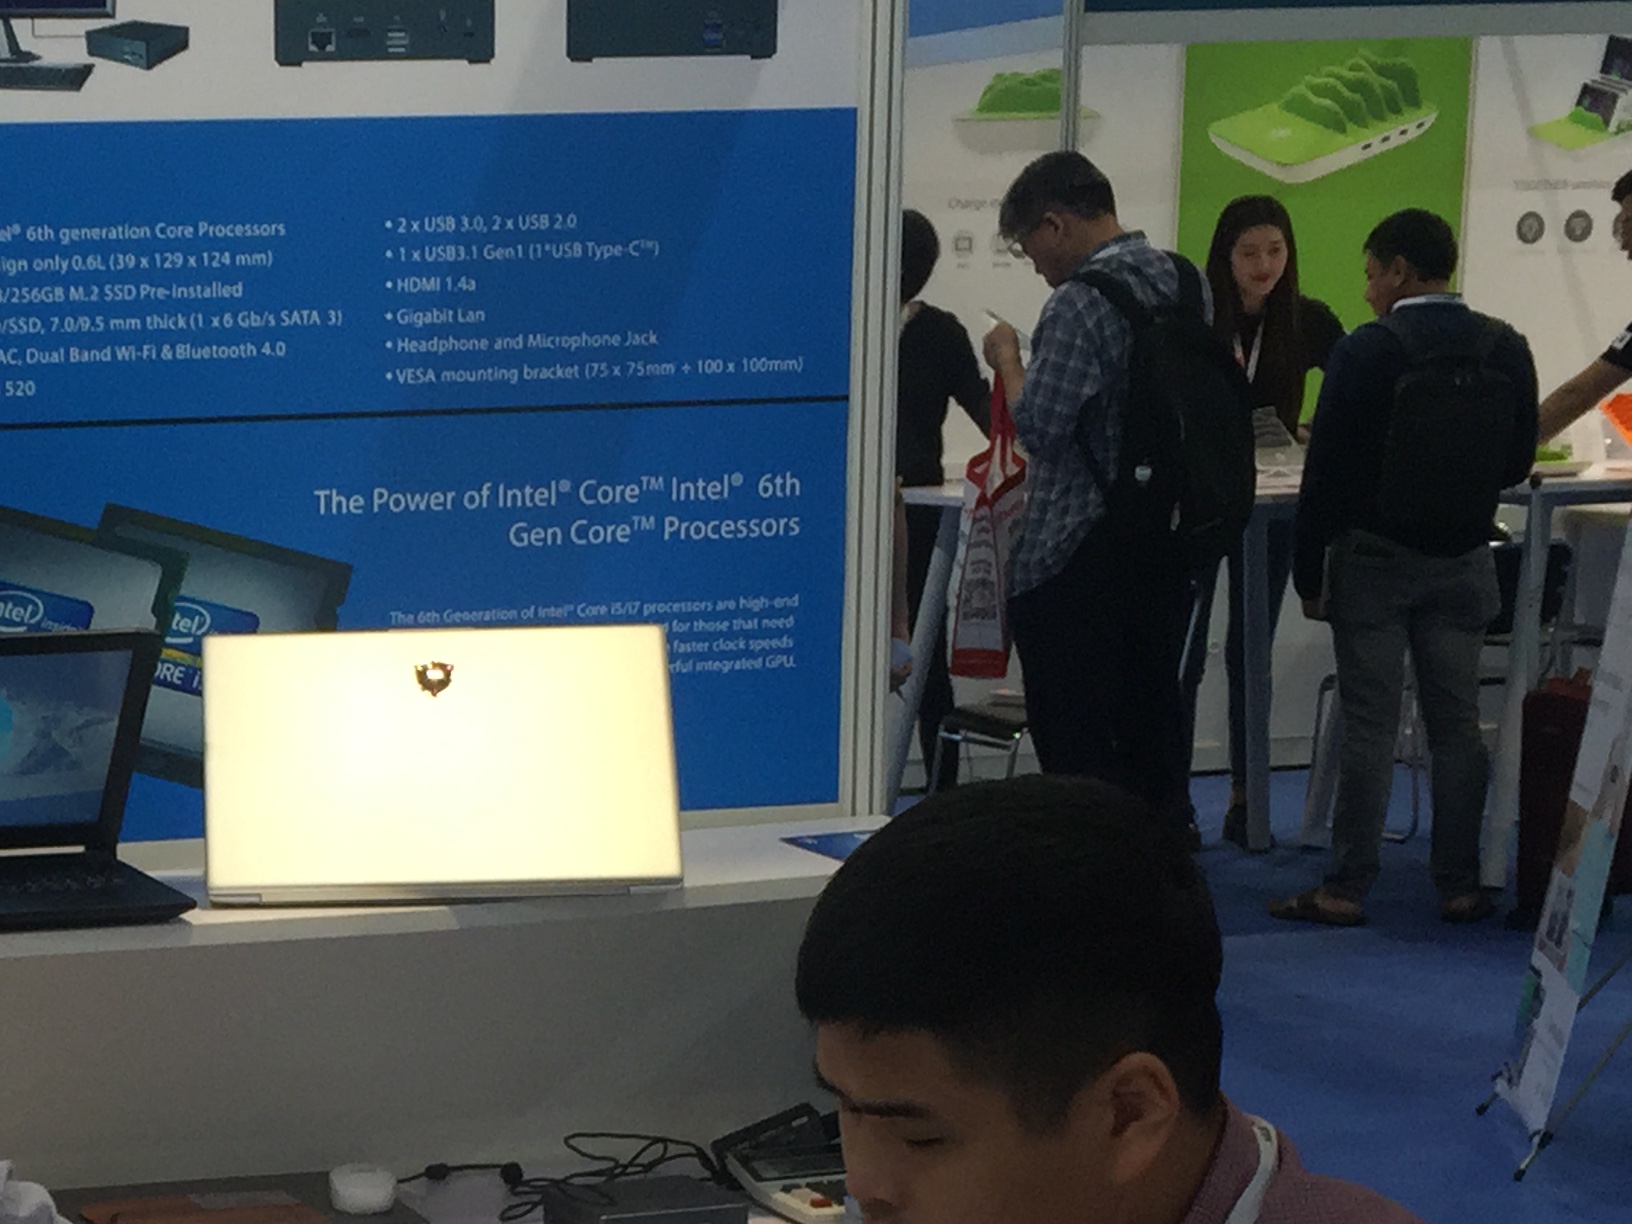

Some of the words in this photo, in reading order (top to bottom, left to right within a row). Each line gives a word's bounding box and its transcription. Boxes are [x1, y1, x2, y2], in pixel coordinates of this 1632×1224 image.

[424, 215, 456, 232] USB
[519, 214, 550, 230] USB
[554, 213, 577, 229] 2.0
[26, 224, 54, 241] 6th
[59, 224, 151, 245] generation
[155, 223, 193, 239] Core
[199, 221, 285, 237] Processors
[33, 255, 69, 274] only
[71, 255, 105, 271] 0.6L
[155, 252, 183, 268] 129
[202, 252, 231, 267] 124
[425, 245, 477, 262] USB3.1
[483, 244, 522, 260] Gen1
[69, 286, 99, 301] M.2
[104, 284, 137, 301] SSD
[140, 281, 243, 299] Pre-installed
[397, 277, 440, 293] HDMI
[446, 276, 476, 291] 1.4a
[146, 313, 187, 329] thick
[281, 310, 320, 326] SATA
[397, 308, 453, 327] Gigabit
[458, 309, 485, 323] Lan
[26, 348, 64, 364] Dual
[70, 346, 111, 362] Band
[115, 344, 156, 361] Wi-Fi
[176, 342, 257, 359] Bluetooth
[261, 341, 286, 356] 4.0
[397, 336, 489, 355] Headphone
[494, 334, 523, 350] and
[527, 332, 621, 351] Microphone
[625, 330, 658, 345] Jack
[396, 367, 436, 384] VESA
[441, 367, 518, 384] mounting
[523, 364, 579, 380] bracket
[6, 380, 35, 396] 520
[314, 489, 364, 515] The
[373, 488, 455, 512] Power
[464, 482, 492, 509] of
[759, 472, 800, 497] 6th
[509, 522, 562, 547] Gen
[664, 516, 799, 540] Processors
